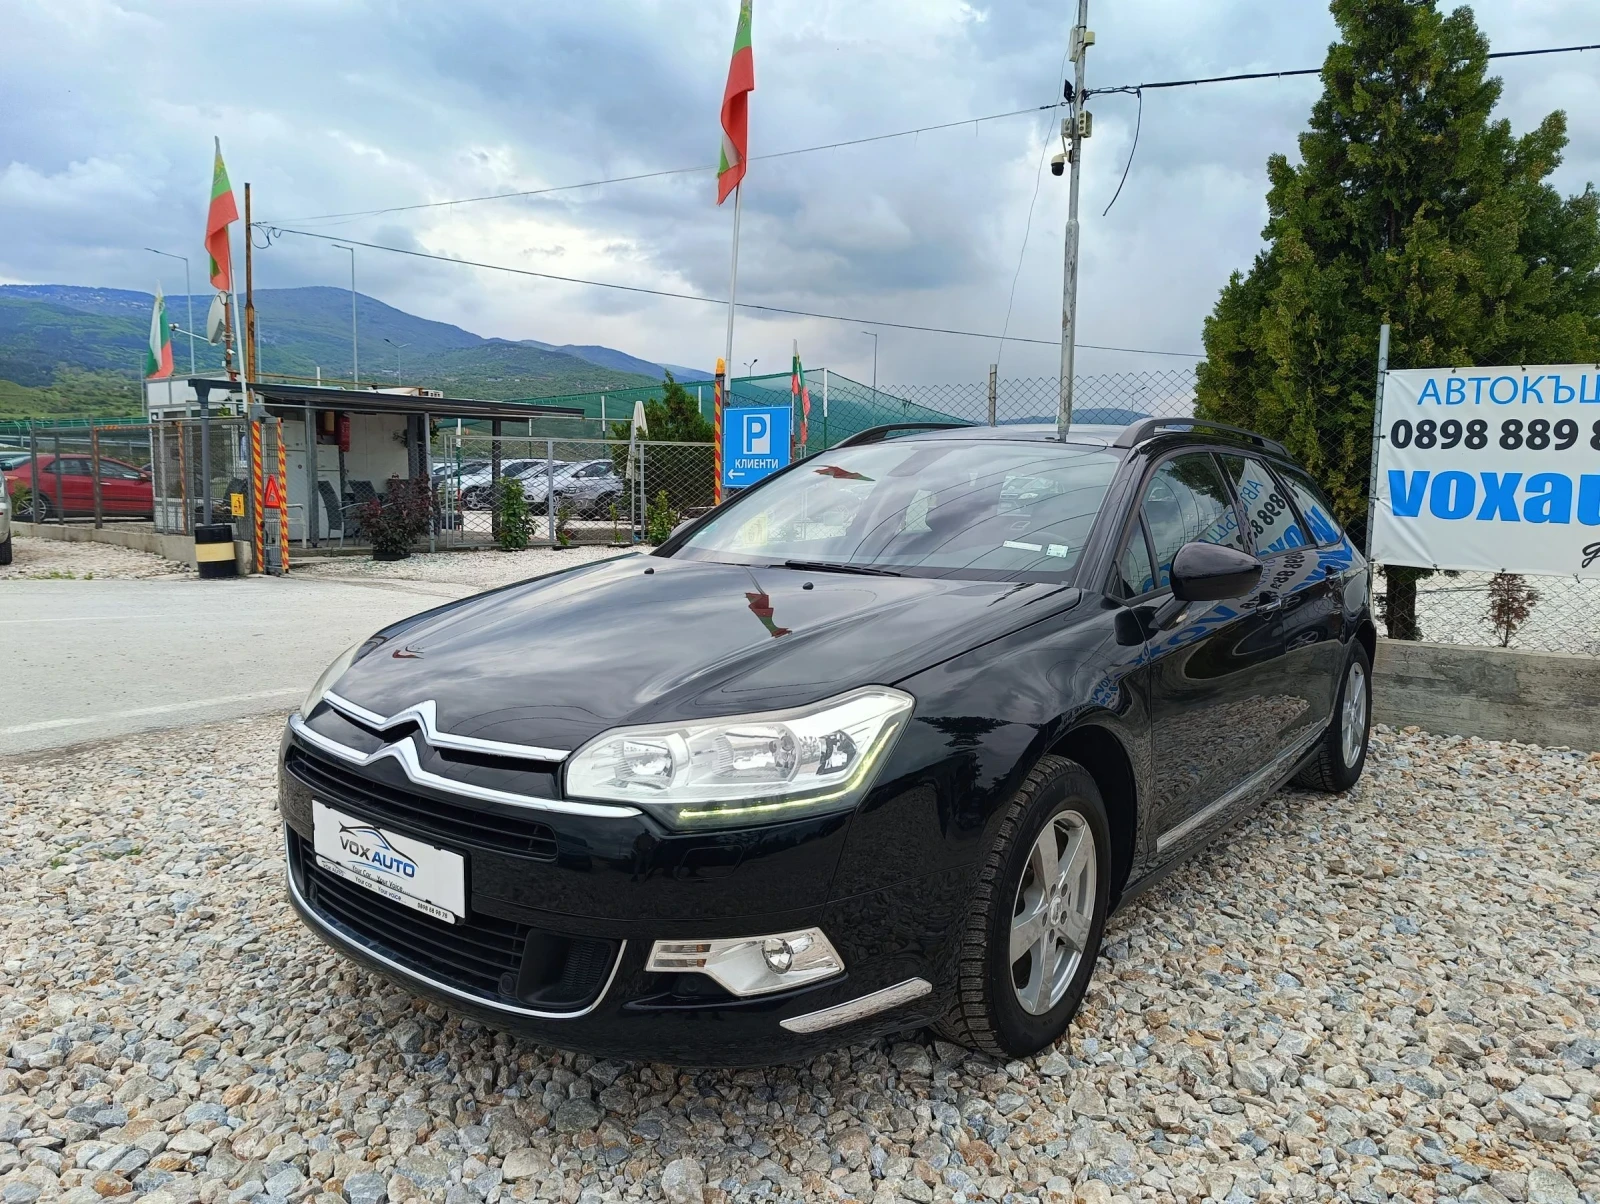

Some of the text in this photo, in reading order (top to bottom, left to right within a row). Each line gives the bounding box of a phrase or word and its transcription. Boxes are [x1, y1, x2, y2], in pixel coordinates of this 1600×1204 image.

[746, 416, 767, 453] P
[1390, 419, 1489, 450] 0898
[1499, 418, 1579, 451] 889
[735, 458, 779, 469] КЛИЕНТИ
[340, 835, 415, 878] VOX AUTO
